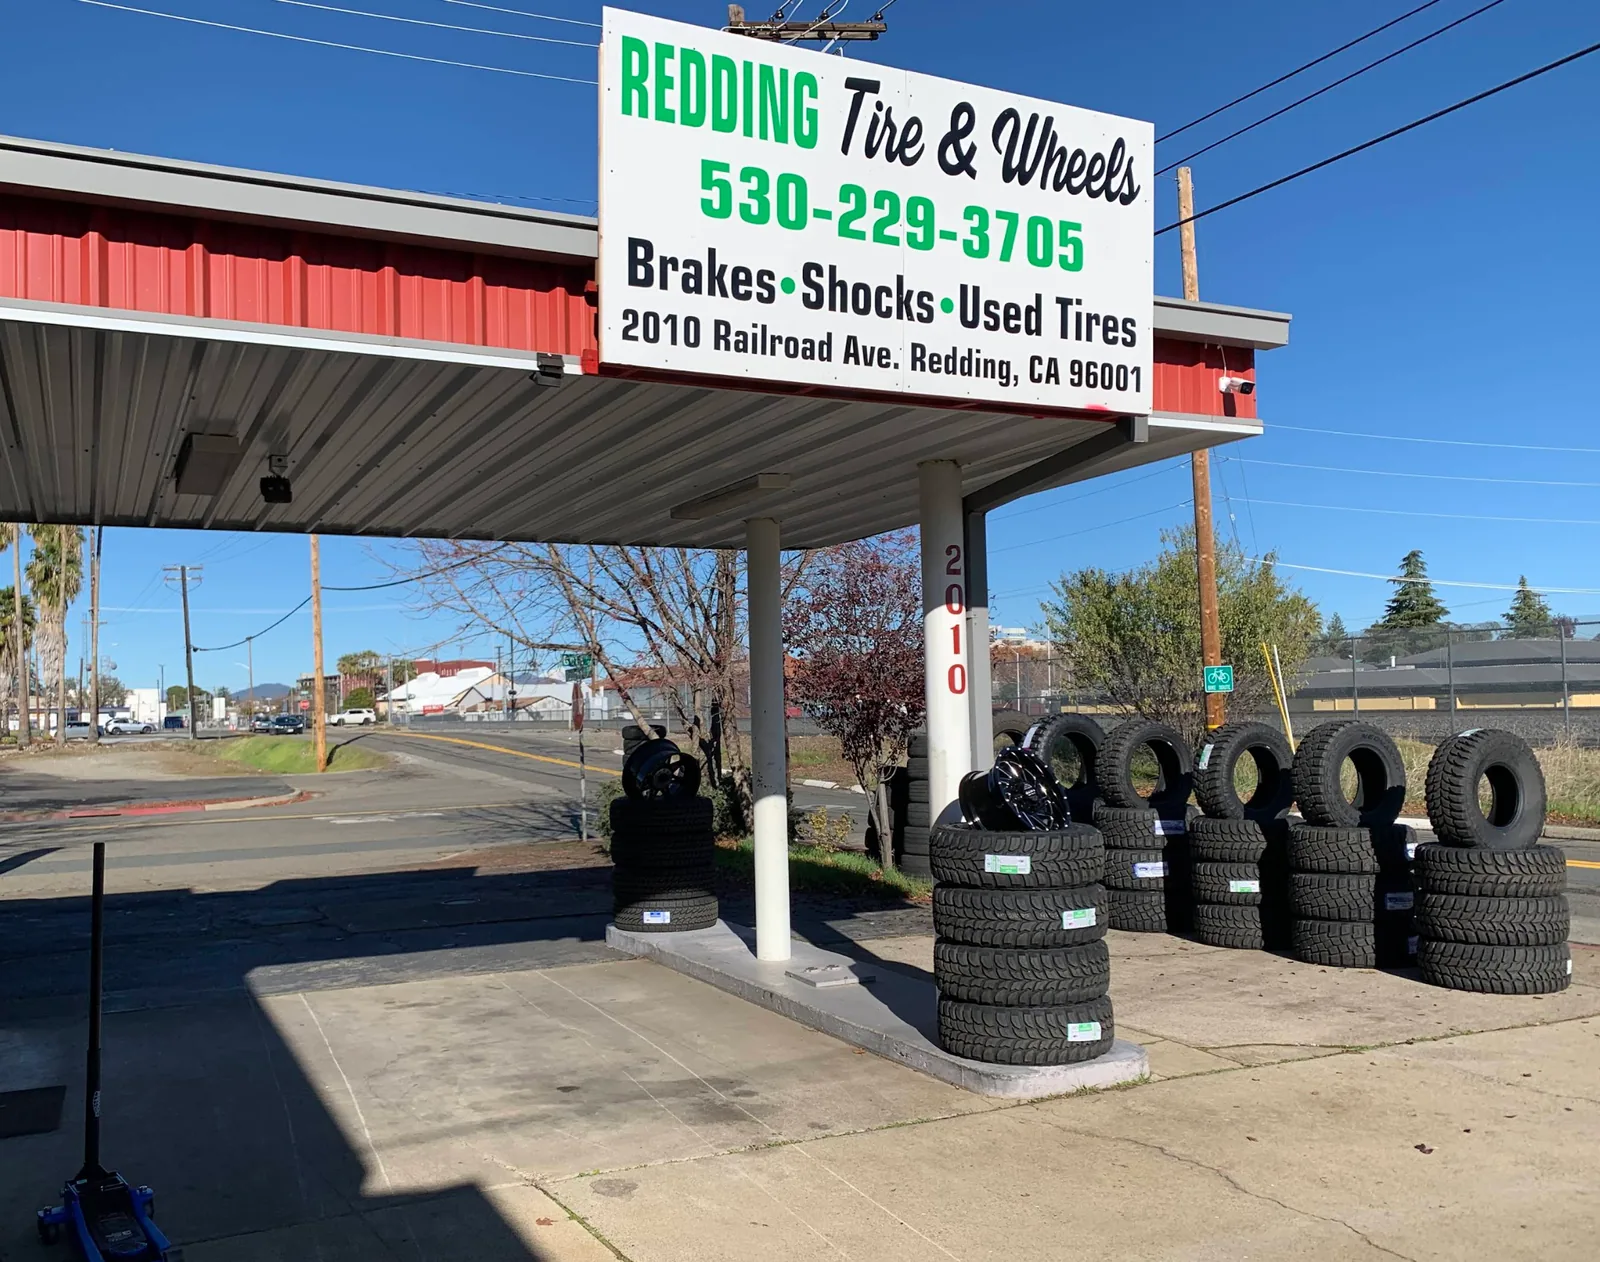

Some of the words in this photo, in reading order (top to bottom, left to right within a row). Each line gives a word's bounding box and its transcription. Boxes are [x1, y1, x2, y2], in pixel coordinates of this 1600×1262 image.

[621, 34, 819, 150] REDDING
[840, 76, 925, 167] Tire
[937, 101, 978, 181] &
[991, 107, 1141, 206] Wheels
[700, 158, 1084, 273] 530-229-3705
[627, 236, 776, 305] Brakes
[801, 261, 935, 324] Shocks
[959, 283, 1043, 337] Used
[1055, 296, 1137, 348] Tires
[621, 308, 701, 349] 2010
[713, 318, 833, 363] Railroad
[842, 334, 900, 370] Ave.
[910, 342, 1019, 388] Redding,
[1029, 354, 1061, 386] CA
[1069, 359, 1141, 393] 96001
[944, 544, 967, 695] 2010
